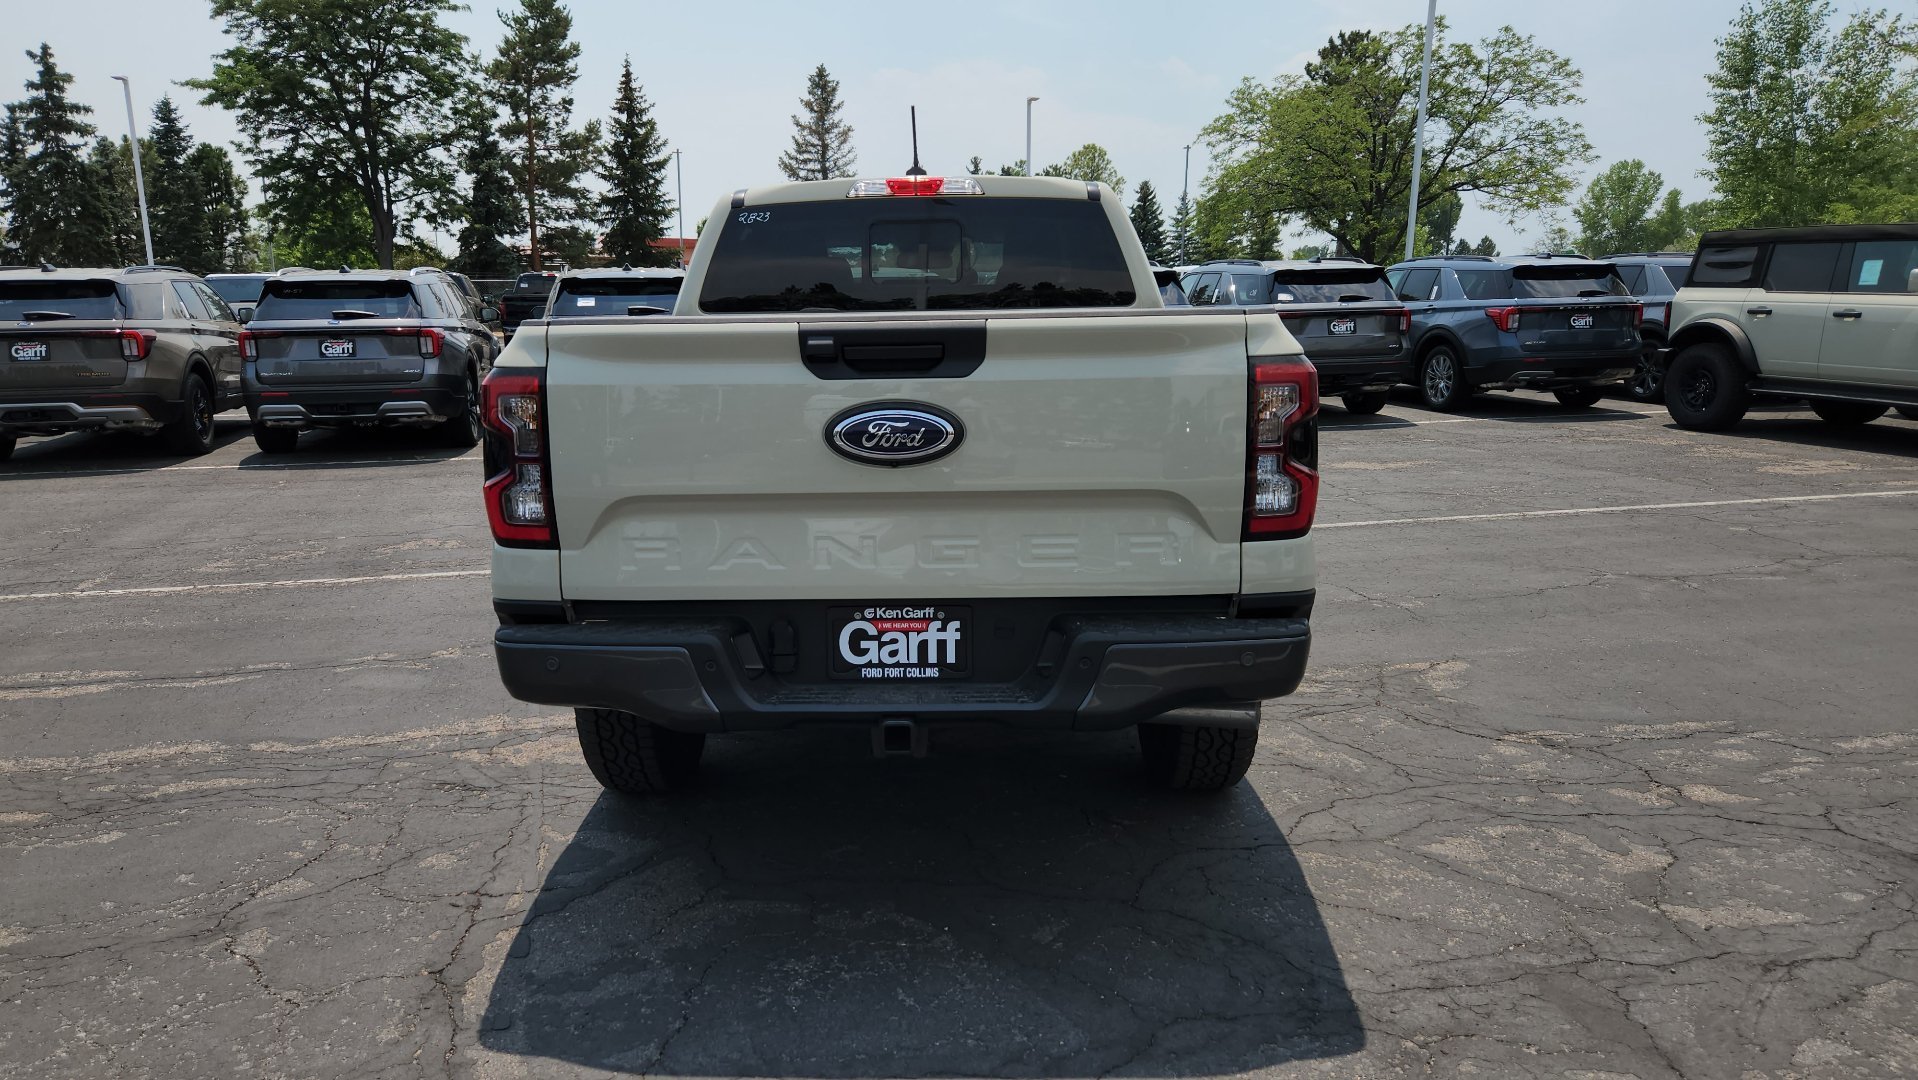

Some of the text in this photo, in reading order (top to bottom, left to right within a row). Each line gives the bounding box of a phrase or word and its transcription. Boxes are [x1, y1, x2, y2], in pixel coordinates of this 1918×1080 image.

[738, 211, 771, 224] 2823
[1330, 321, 1355, 332] Garff
[1570, 316, 1593, 326] Garff
[11, 344, 47, 358] Garff
[321, 342, 353, 354] Garff
[862, 420, 925, 447] Ford
[620, 532, 1179, 571] RANGER
[877, 607, 935, 619] Ken Garff
[839, 620, 960, 665] Garff
[861, 667, 939, 678] FORD FORT COLLINS
